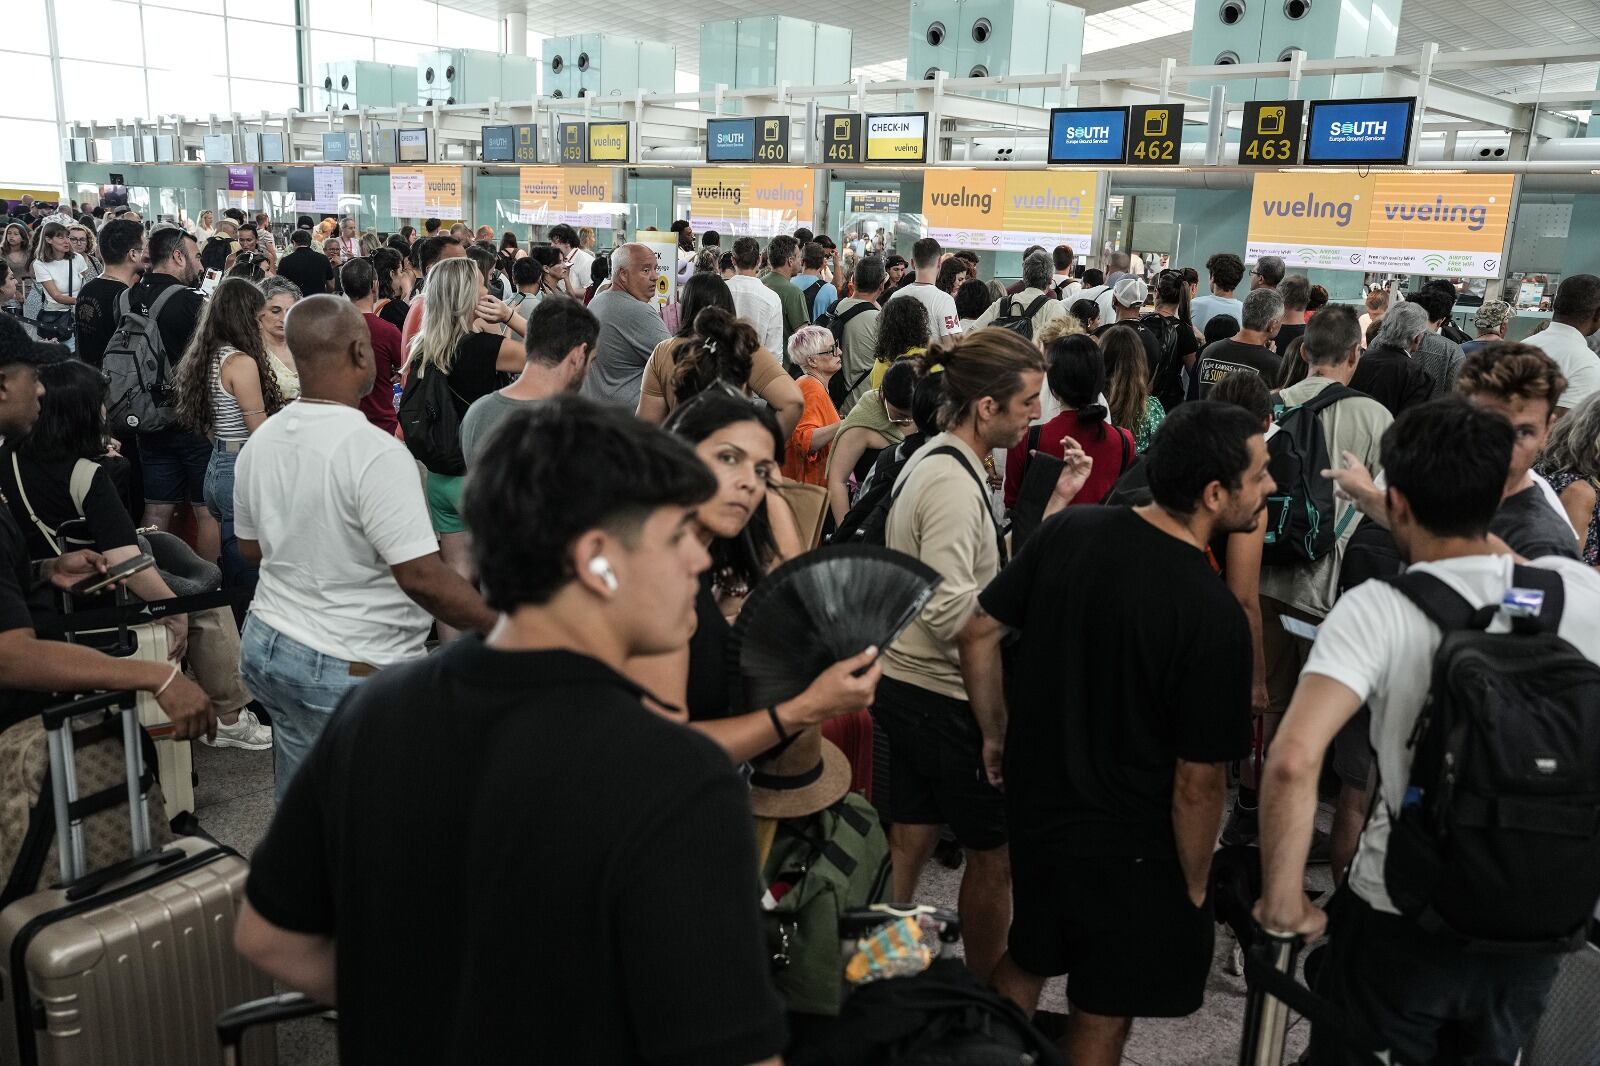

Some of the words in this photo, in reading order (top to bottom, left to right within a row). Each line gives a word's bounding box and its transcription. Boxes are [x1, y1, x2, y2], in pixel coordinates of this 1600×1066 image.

[872, 122, 910, 132] CHECK-IN
[1066, 126, 1110, 139] SOUTH
[1330, 121, 1388, 135] SOUTH
[594, 134, 622, 150] vueling
[717, 133, 744, 143] SOUTH
[347, 149, 360, 161] 456
[517, 147, 534, 160] 458
[563, 146, 581, 160] 459
[758, 144, 784, 160] 460
[828, 144, 854, 160] 461
[894, 144, 918, 154] vueling
[1133, 140, 1175, 160] 462
[1246, 139, 1291, 160] 463
[428, 178, 456, 196] vueling
[524, 180, 558, 199] vueling
[569, 179, 605, 200] vueling
[697, 181, 741, 205] vueling
[756, 183, 803, 207] vueling
[931, 186, 992, 214] vueling
[1013, 188, 1081, 218] vueling
[1263, 192, 1353, 227] vueling
[1385, 194, 1487, 231] vueling
